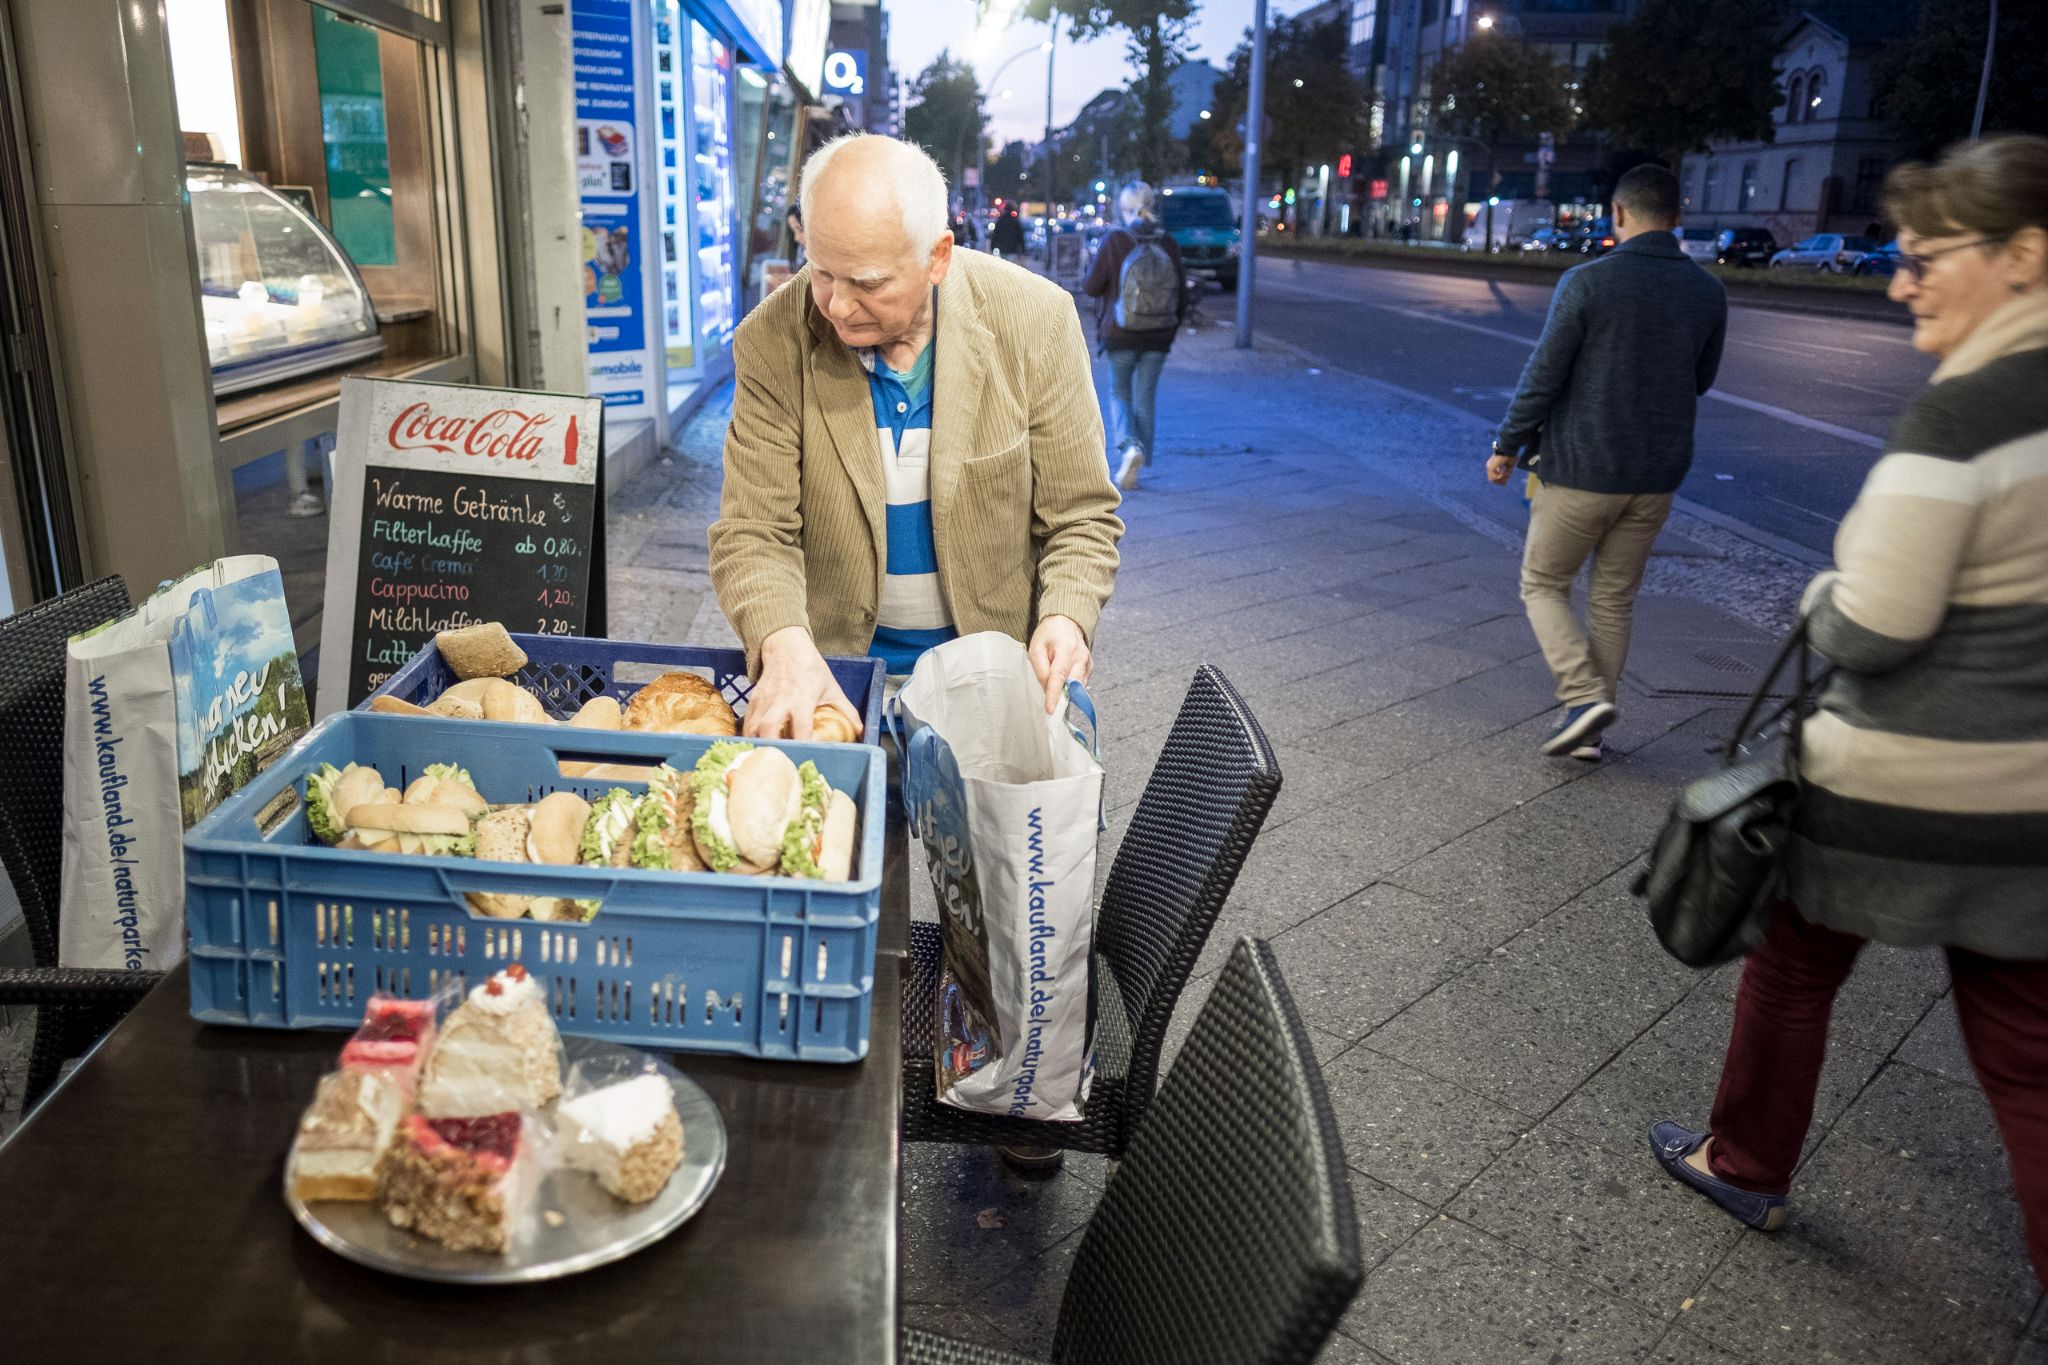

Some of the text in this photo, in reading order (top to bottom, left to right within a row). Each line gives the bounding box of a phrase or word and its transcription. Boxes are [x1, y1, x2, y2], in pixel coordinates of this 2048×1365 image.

[388, 402, 556, 461] Coca-Cola
[373, 479, 547, 527] Warme Getränke
[372, 520, 483, 555] Filterkaffee
[515, 535, 537, 554] ab
[370, 576, 470, 606] Cappucino
